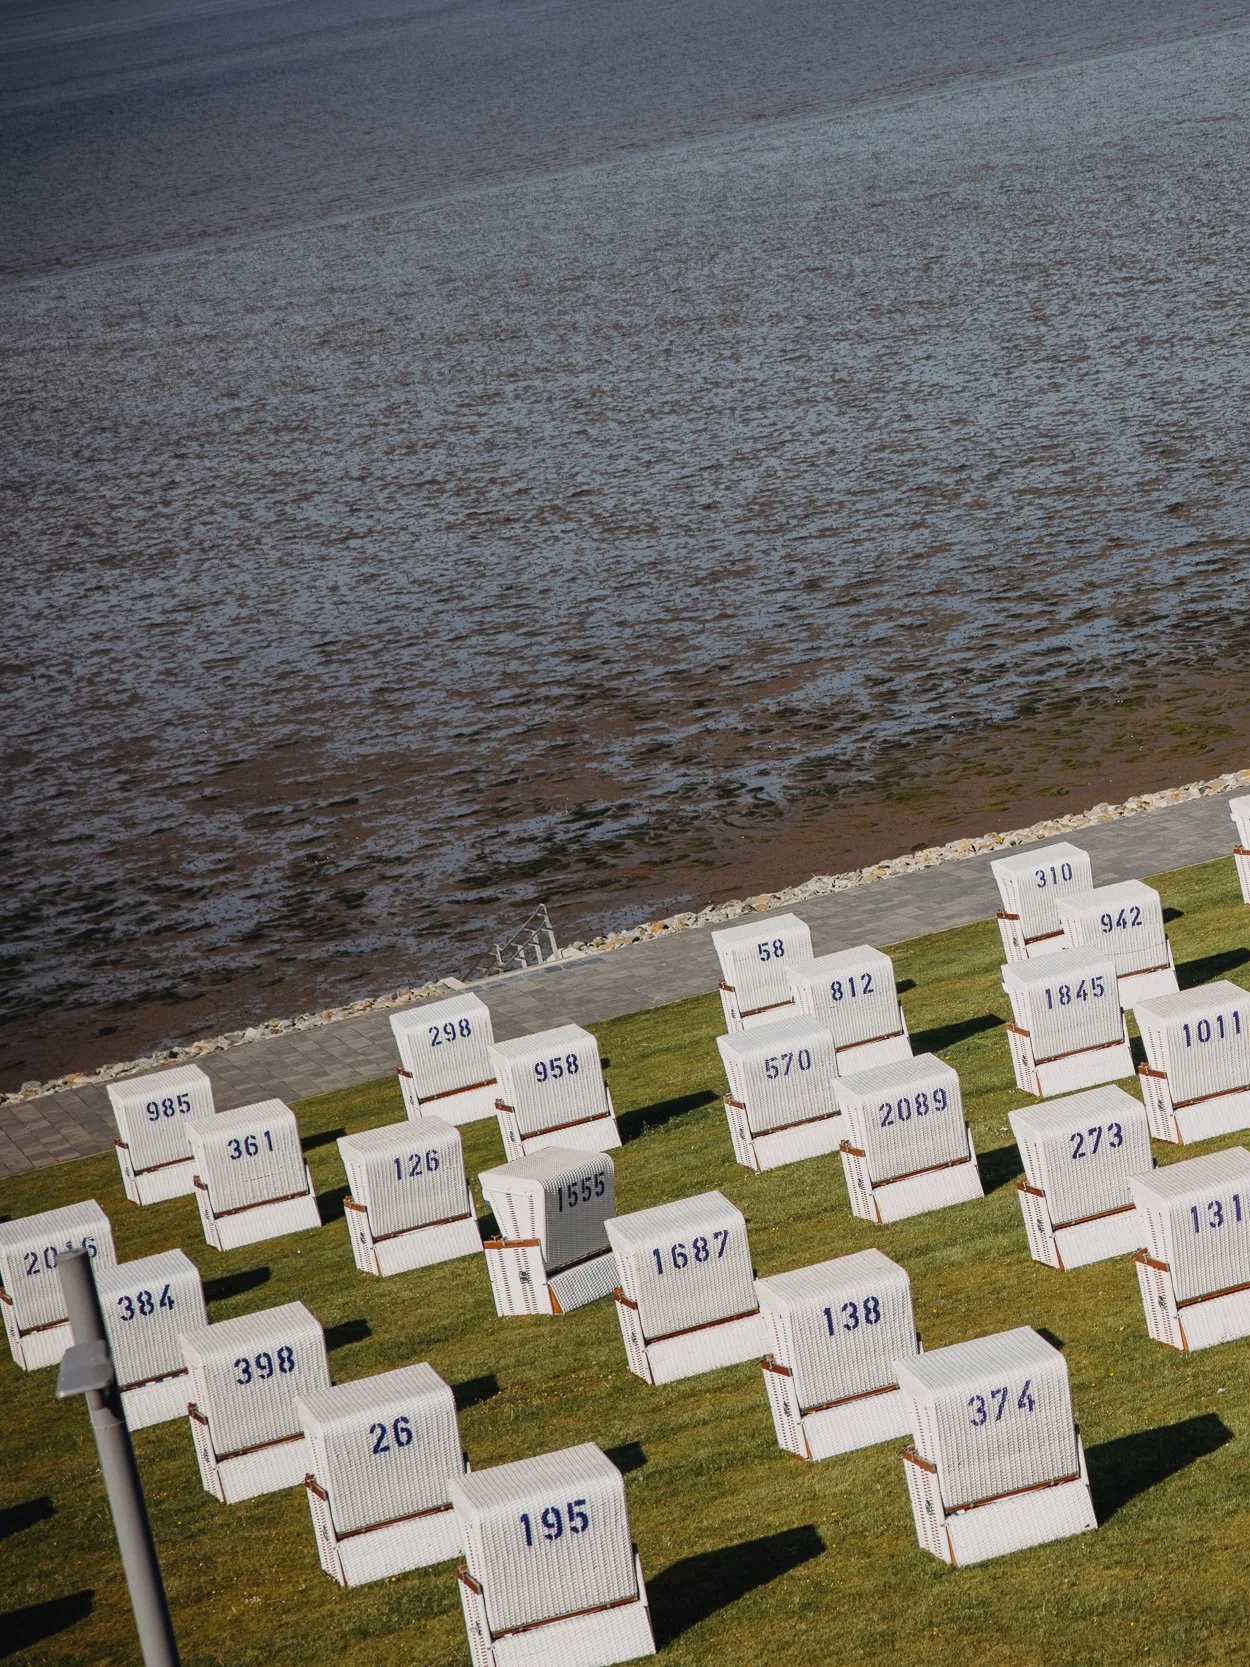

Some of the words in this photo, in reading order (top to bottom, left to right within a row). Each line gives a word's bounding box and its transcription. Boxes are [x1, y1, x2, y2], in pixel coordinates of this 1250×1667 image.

[1034, 862, 1074, 889] 310
[1100, 905, 1143, 934] 942
[757, 938, 786, 962] 58
[830, 972, 875, 1002] 812
[1044, 975, 1105, 1010] 1845
[428, 1018, 472, 1048] 298
[1182, 1010, 1241, 1048] 1011
[533, 1053, 580, 1083] 958
[764, 1049, 812, 1080] 570
[145, 1092, 192, 1122] 985
[878, 1087, 948, 1128] 2089
[227, 1130, 274, 1161] 361
[1069, 1122, 1124, 1160] 273
[393, 1149, 440, 1181] 126
[558, 1172, 604, 1212] 1555
[652, 1229, 729, 1276] 1687
[117, 1284, 175, 1322] 384
[823, 1295, 882, 1337] 138
[233, 1345, 296, 1386] 398
[967, 1379, 1036, 1427] 374
[369, 1416, 414, 1455] 26
[519, 1499, 590, 1548] 195
